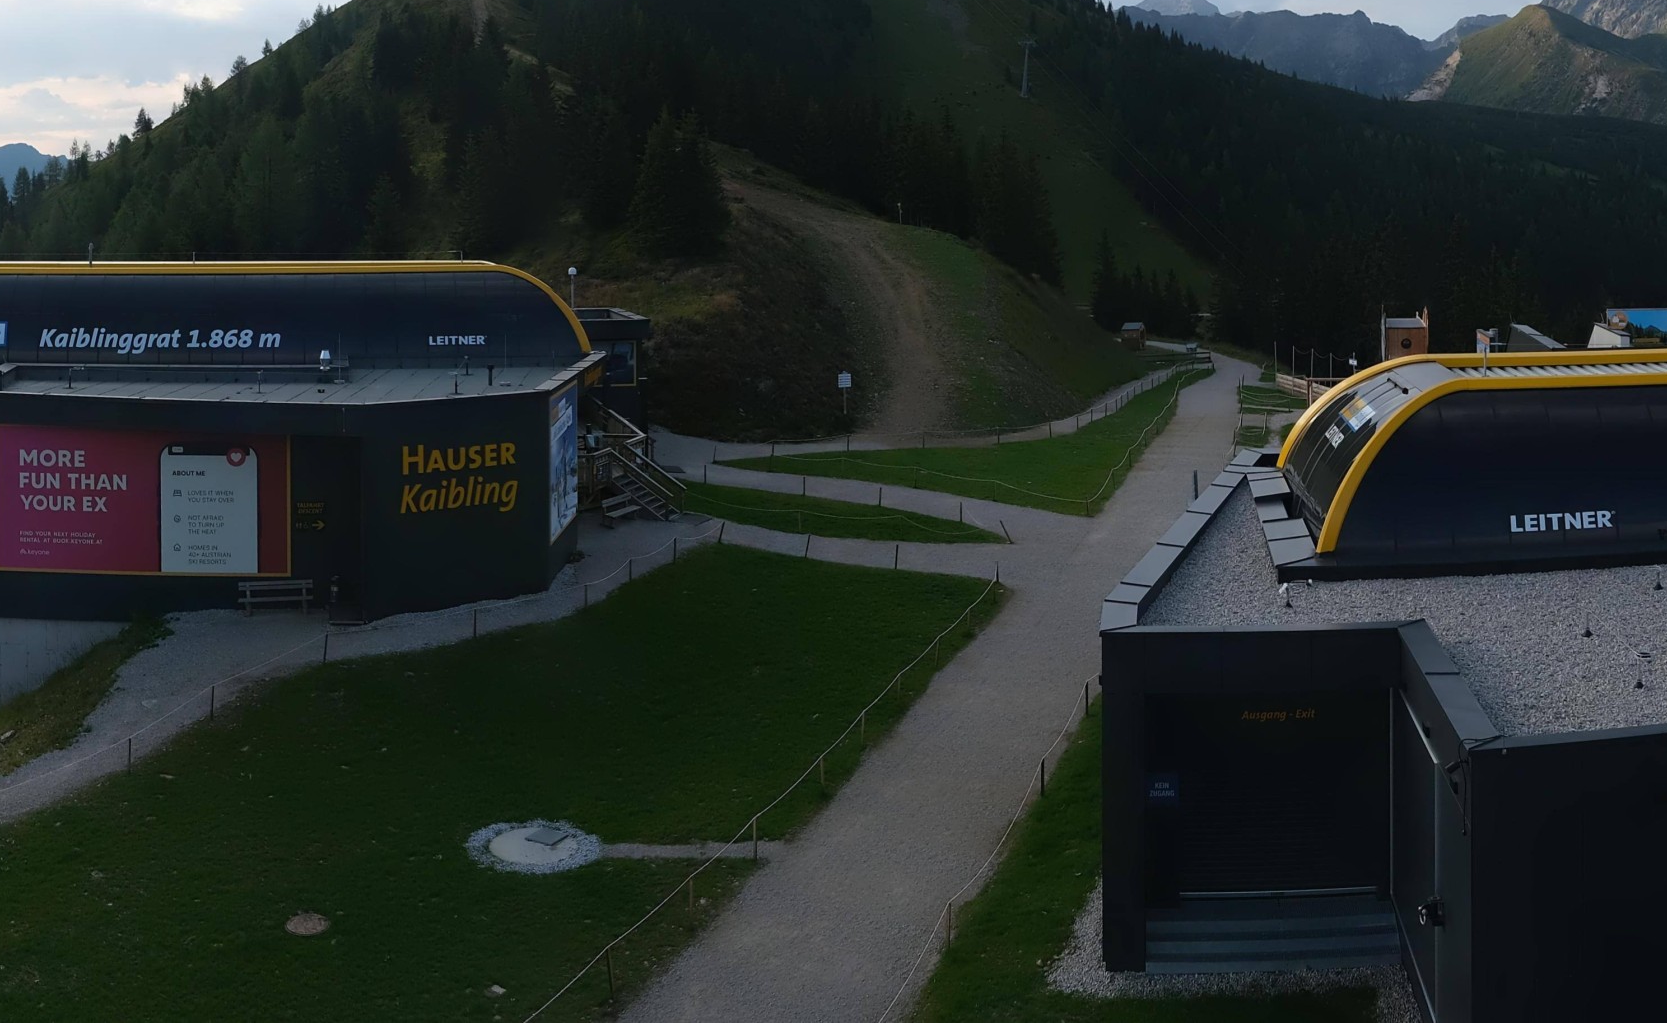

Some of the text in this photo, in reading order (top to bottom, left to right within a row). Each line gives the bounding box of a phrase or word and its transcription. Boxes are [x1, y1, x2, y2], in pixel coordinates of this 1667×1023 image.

[39, 327, 281, 354] Kaiblinggrat 1.868 m
[428, 335, 486, 346] LEITNER
[19, 448, 86, 468] MORE
[401, 441, 517, 476] HAUSER
[19, 472, 128, 491] FUN THAN
[20, 494, 108, 513] YOUR EX
[399, 475, 519, 515] Kaibling
[1509, 510, 1613, 533] LEITNER
[1241, 709, 1288, 722] Ausgang
[1295, 708, 1316, 719] Exit
[1148, 789, 1176, 797] ZUGANG
[1154, 781, 1170, 789] KEIN
